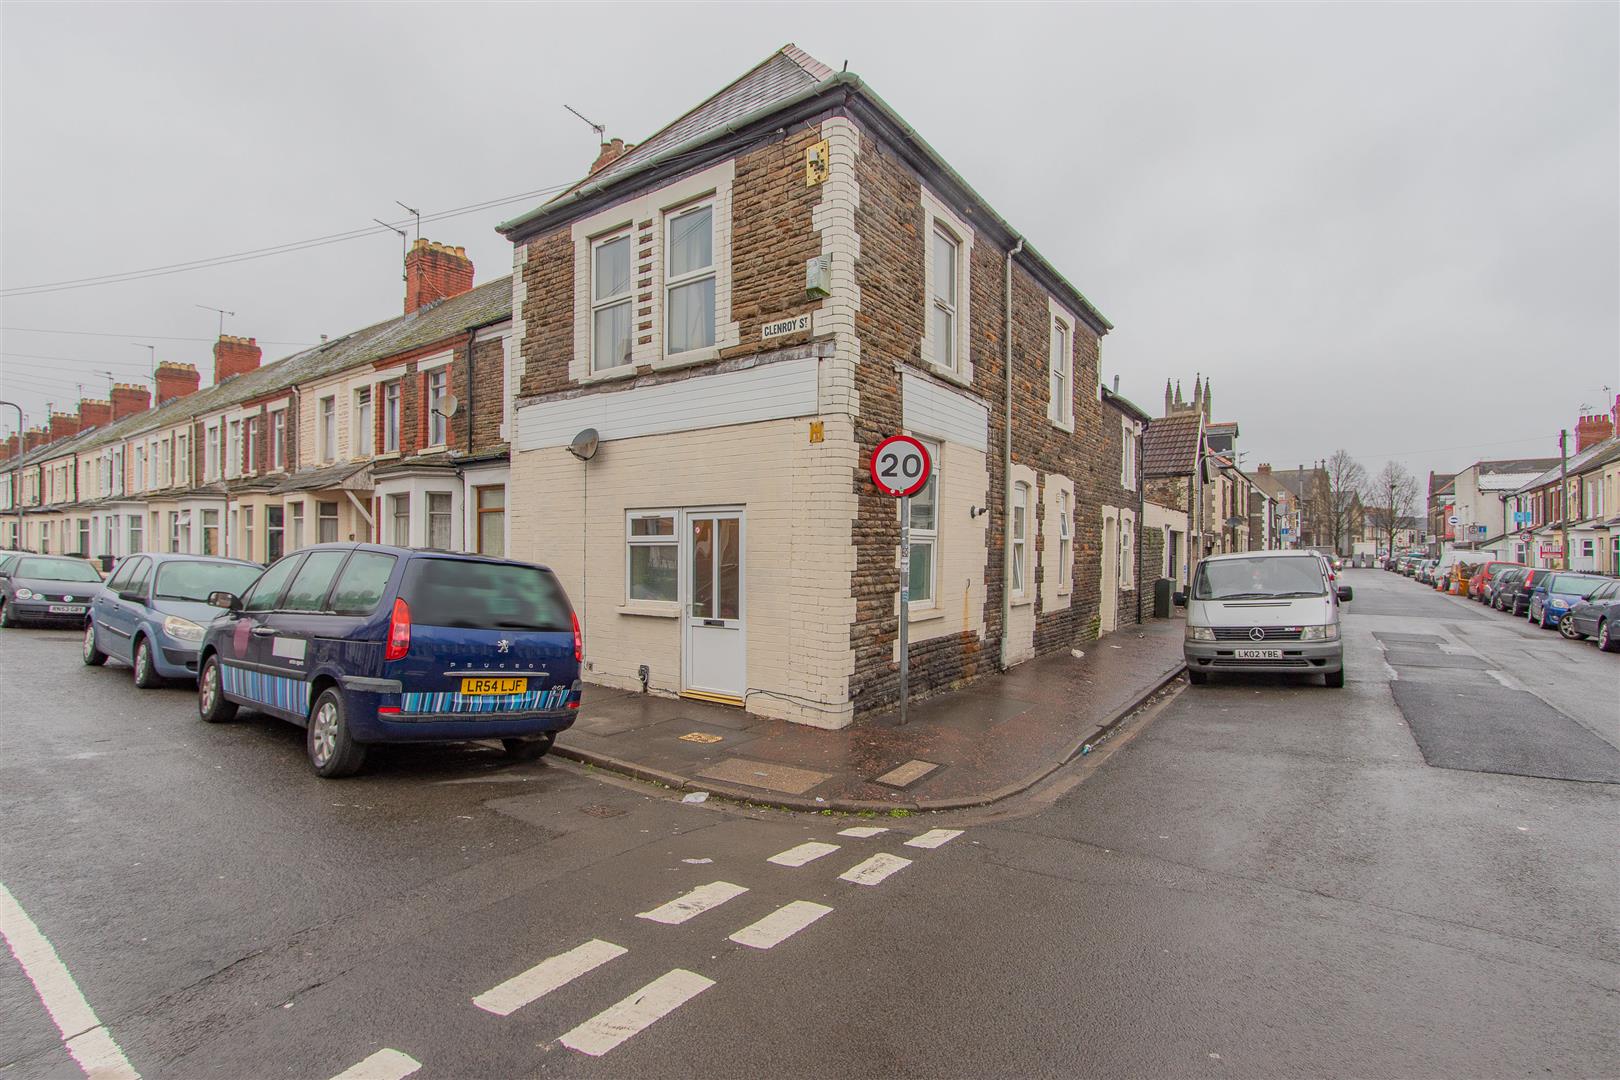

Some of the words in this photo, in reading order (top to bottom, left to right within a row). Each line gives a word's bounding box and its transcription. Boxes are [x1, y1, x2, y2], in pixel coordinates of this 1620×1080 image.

[764, 319, 797, 336] GLENROY
[880, 453, 922, 478] 20
[467, 680, 498, 692] LR54
[501, 680, 522, 692] LJF
